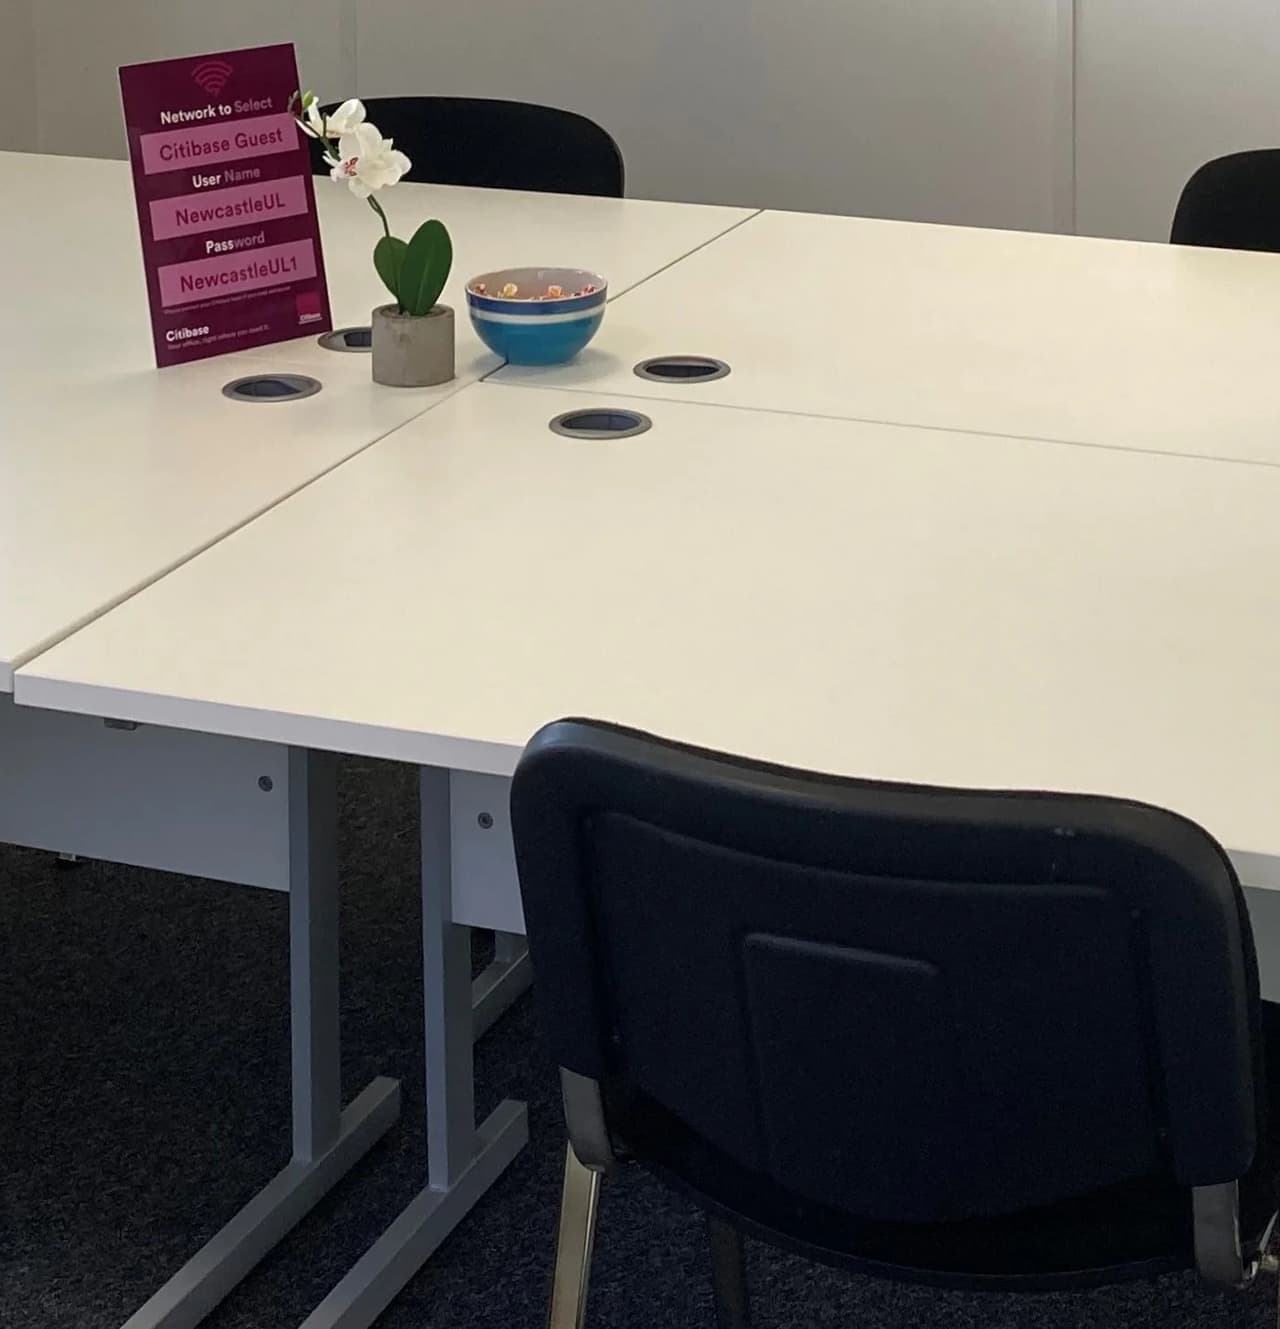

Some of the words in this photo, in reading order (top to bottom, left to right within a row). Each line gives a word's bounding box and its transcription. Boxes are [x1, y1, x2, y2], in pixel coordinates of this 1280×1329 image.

[160, 104, 216, 125] Network
[218, 104, 232, 116] to
[234, 97, 273, 113] Select
[160, 140, 230, 161] Citibase
[235, 128, 283, 149] Guest
[192, 174, 222, 188] User
[224, 168, 261, 183] Name
[175, 192, 286, 226] NewcastleUL
[205, 231, 265, 254] Password
[180, 256, 297, 293] NewcastleUL1
[166, 326, 209, 342] Citibase
